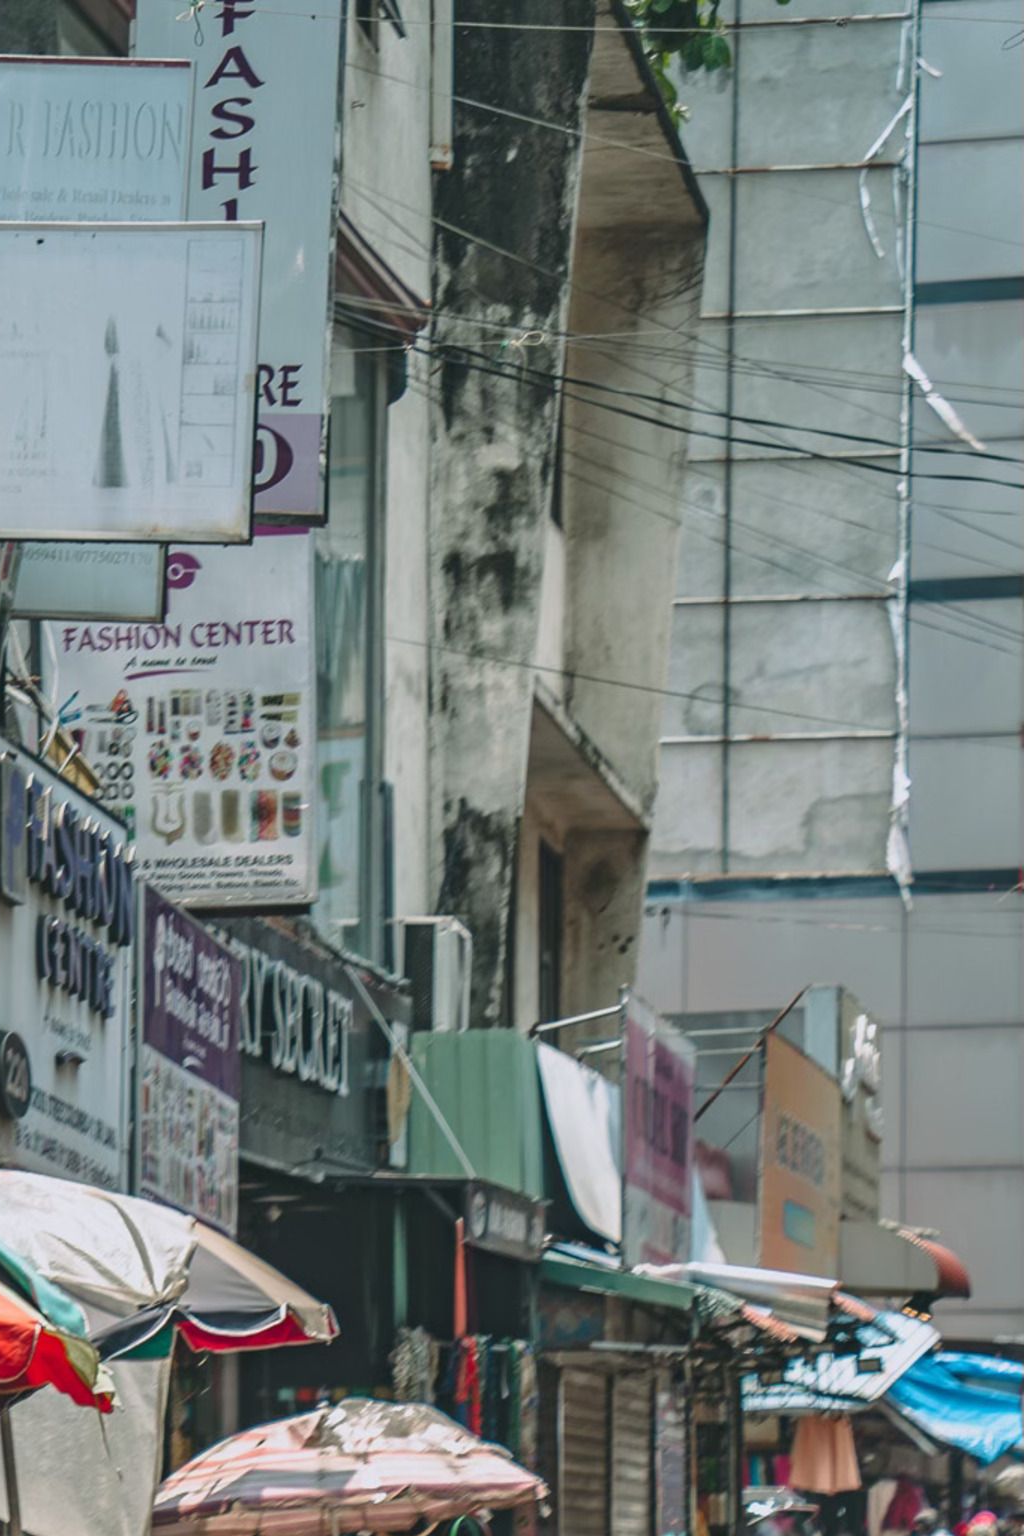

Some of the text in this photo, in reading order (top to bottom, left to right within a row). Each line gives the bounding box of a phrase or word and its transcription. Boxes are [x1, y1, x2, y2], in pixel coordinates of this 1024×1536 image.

[42, 100, 184, 161] FASHION
[57, 187, 68, 203] &
[63, 619, 296, 652] FASHION CENTER
[124, 655, 218, 672] A name to trust
[26, 773, 136, 946] FASHION
[155, 855, 234, 870] WHOLESALE
[234, 853, 294, 867] DEALERS
[271, 958, 353, 1097] SECRET
